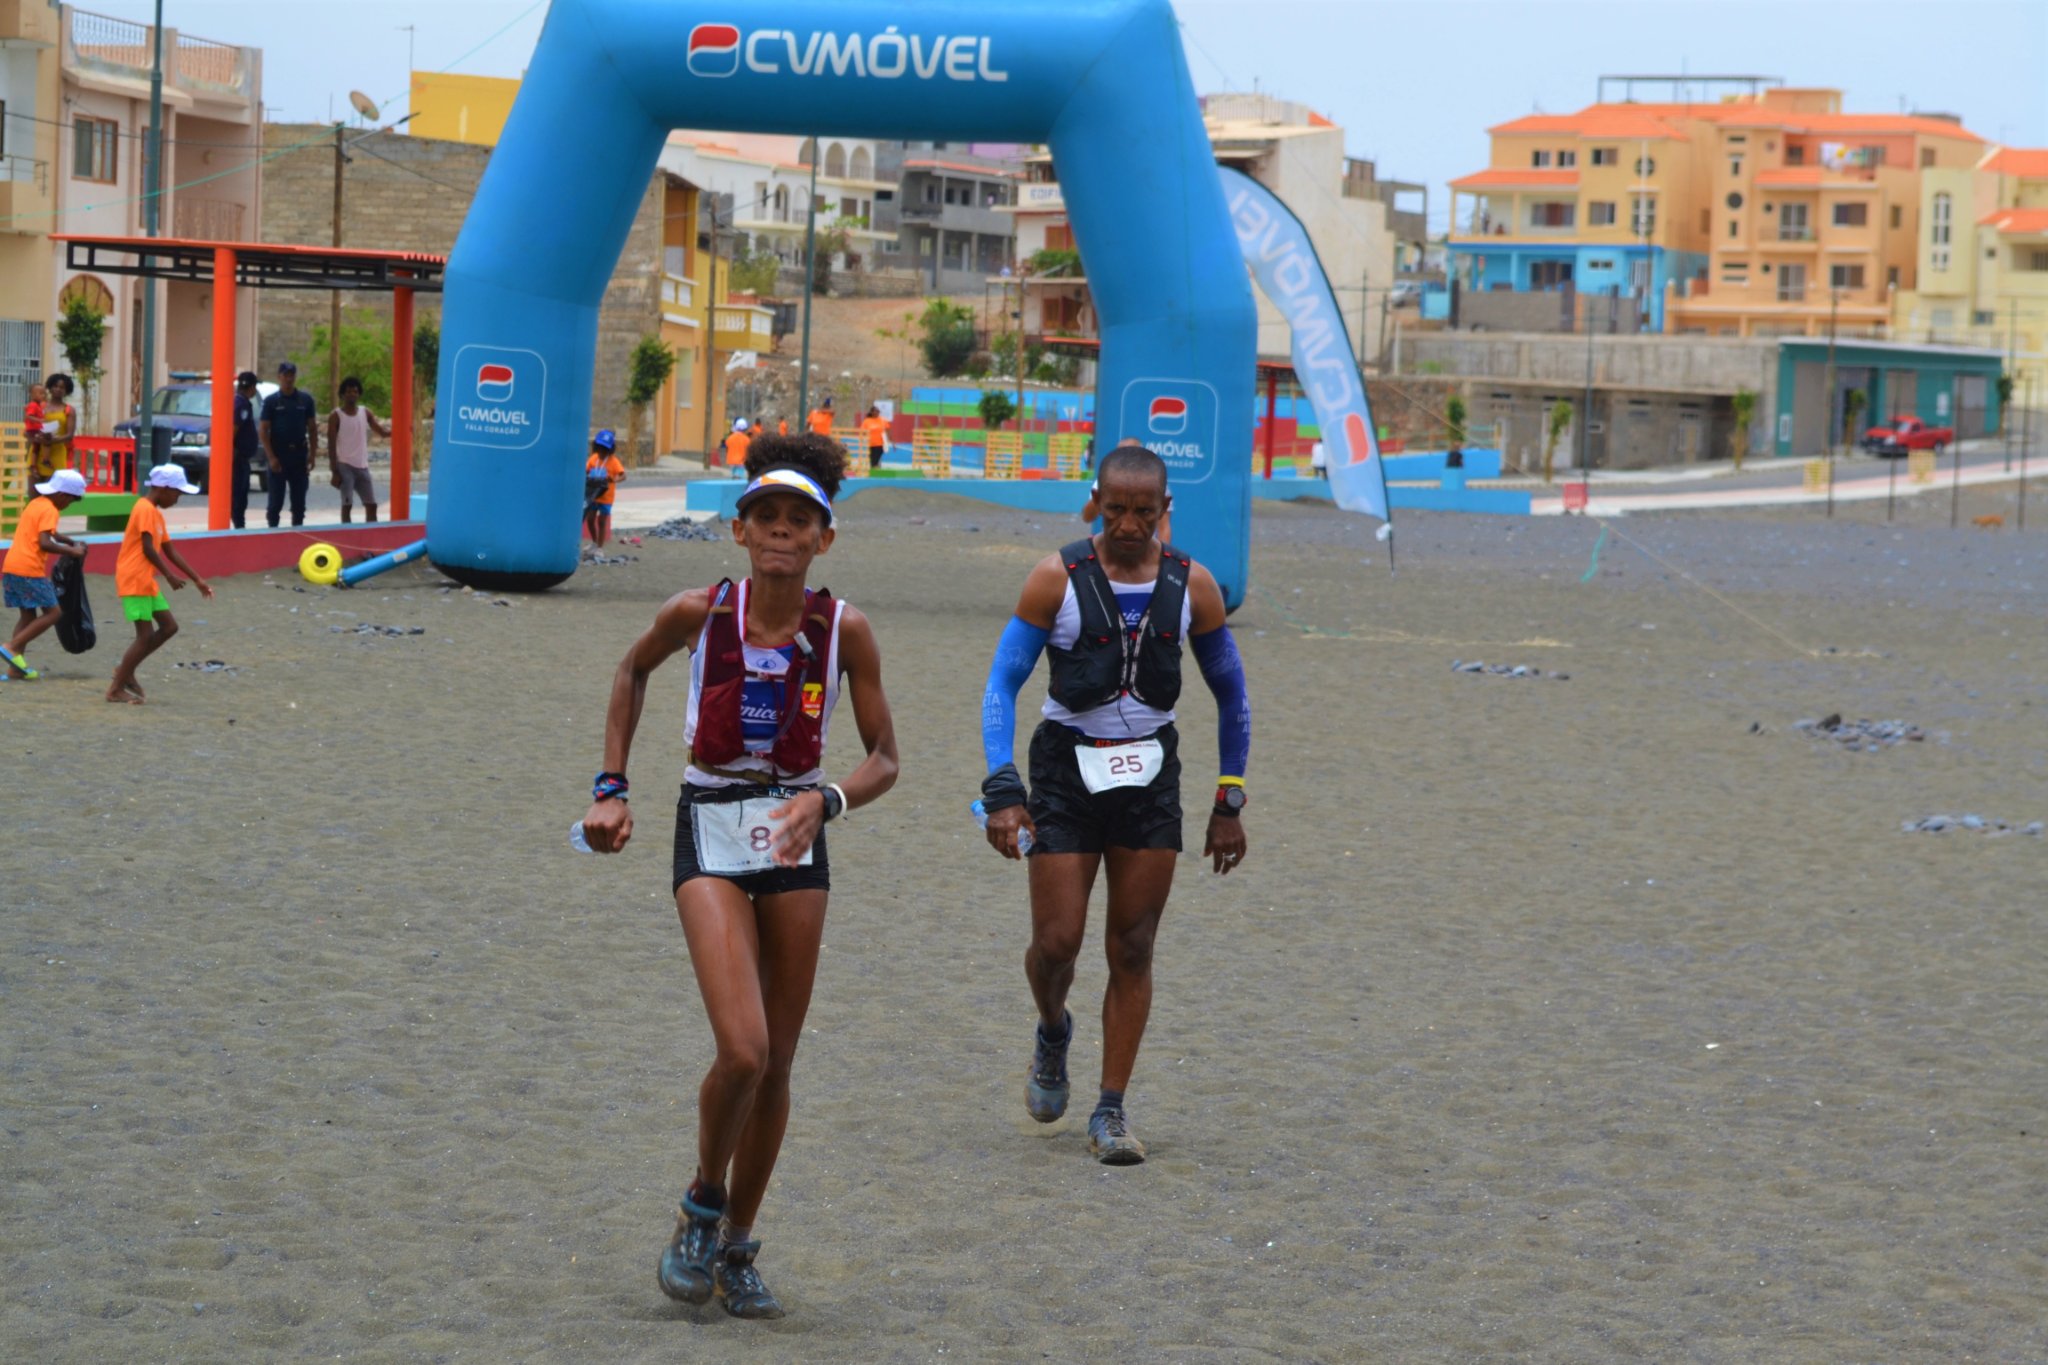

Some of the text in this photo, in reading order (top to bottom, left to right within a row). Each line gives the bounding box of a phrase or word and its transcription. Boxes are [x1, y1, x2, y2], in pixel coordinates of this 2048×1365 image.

[745, 26, 1008, 82] CVMÓVEL
[459, 406, 530, 425] CVMÓVEL
[465, 423, 482, 431] FALA
[1109, 755, 1143, 775] 25
[750, 826, 771, 851] 8
